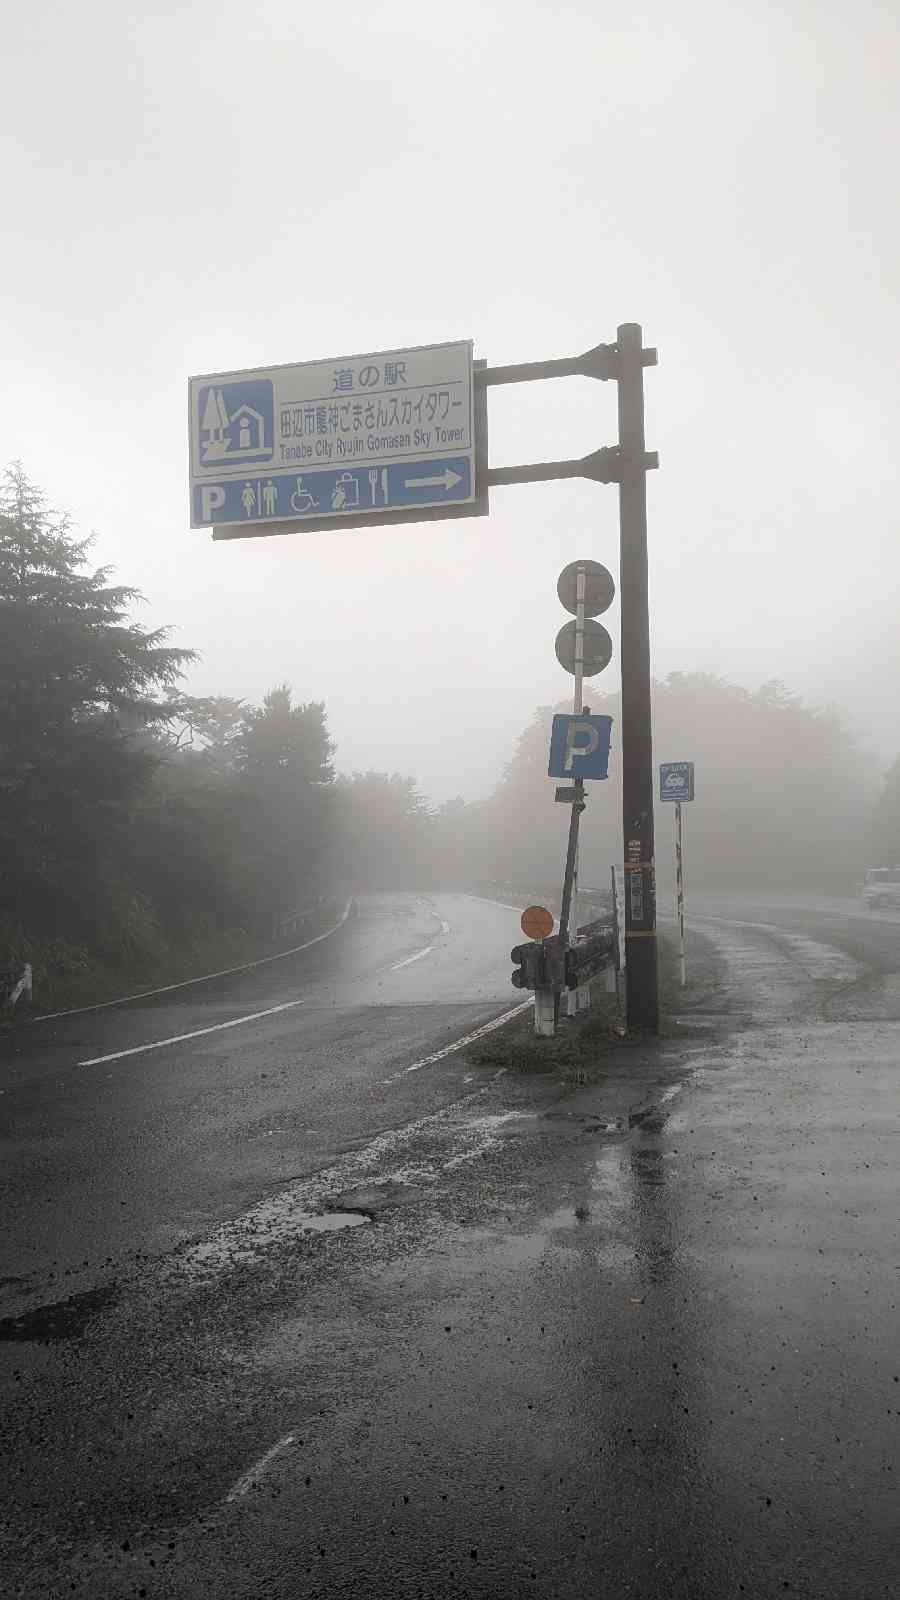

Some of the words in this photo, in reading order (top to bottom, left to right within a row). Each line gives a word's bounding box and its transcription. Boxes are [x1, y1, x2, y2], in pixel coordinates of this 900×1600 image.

[333, 362, 407, 391] 道の駅
[280, 391, 463, 439] 田辺市龍神ごまさんスカイタワー
[280, 443, 312, 460] Tanabe
[315, 440, 333, 458] City
[336, 437, 364, 456] Ryujin
[367, 432, 410, 450] Gomasan
[414, 428, 431, 446] Sky
[435, 426, 464, 442] Tower
[202, 486, 226, 521] P
[564, 723, 598, 770] P
